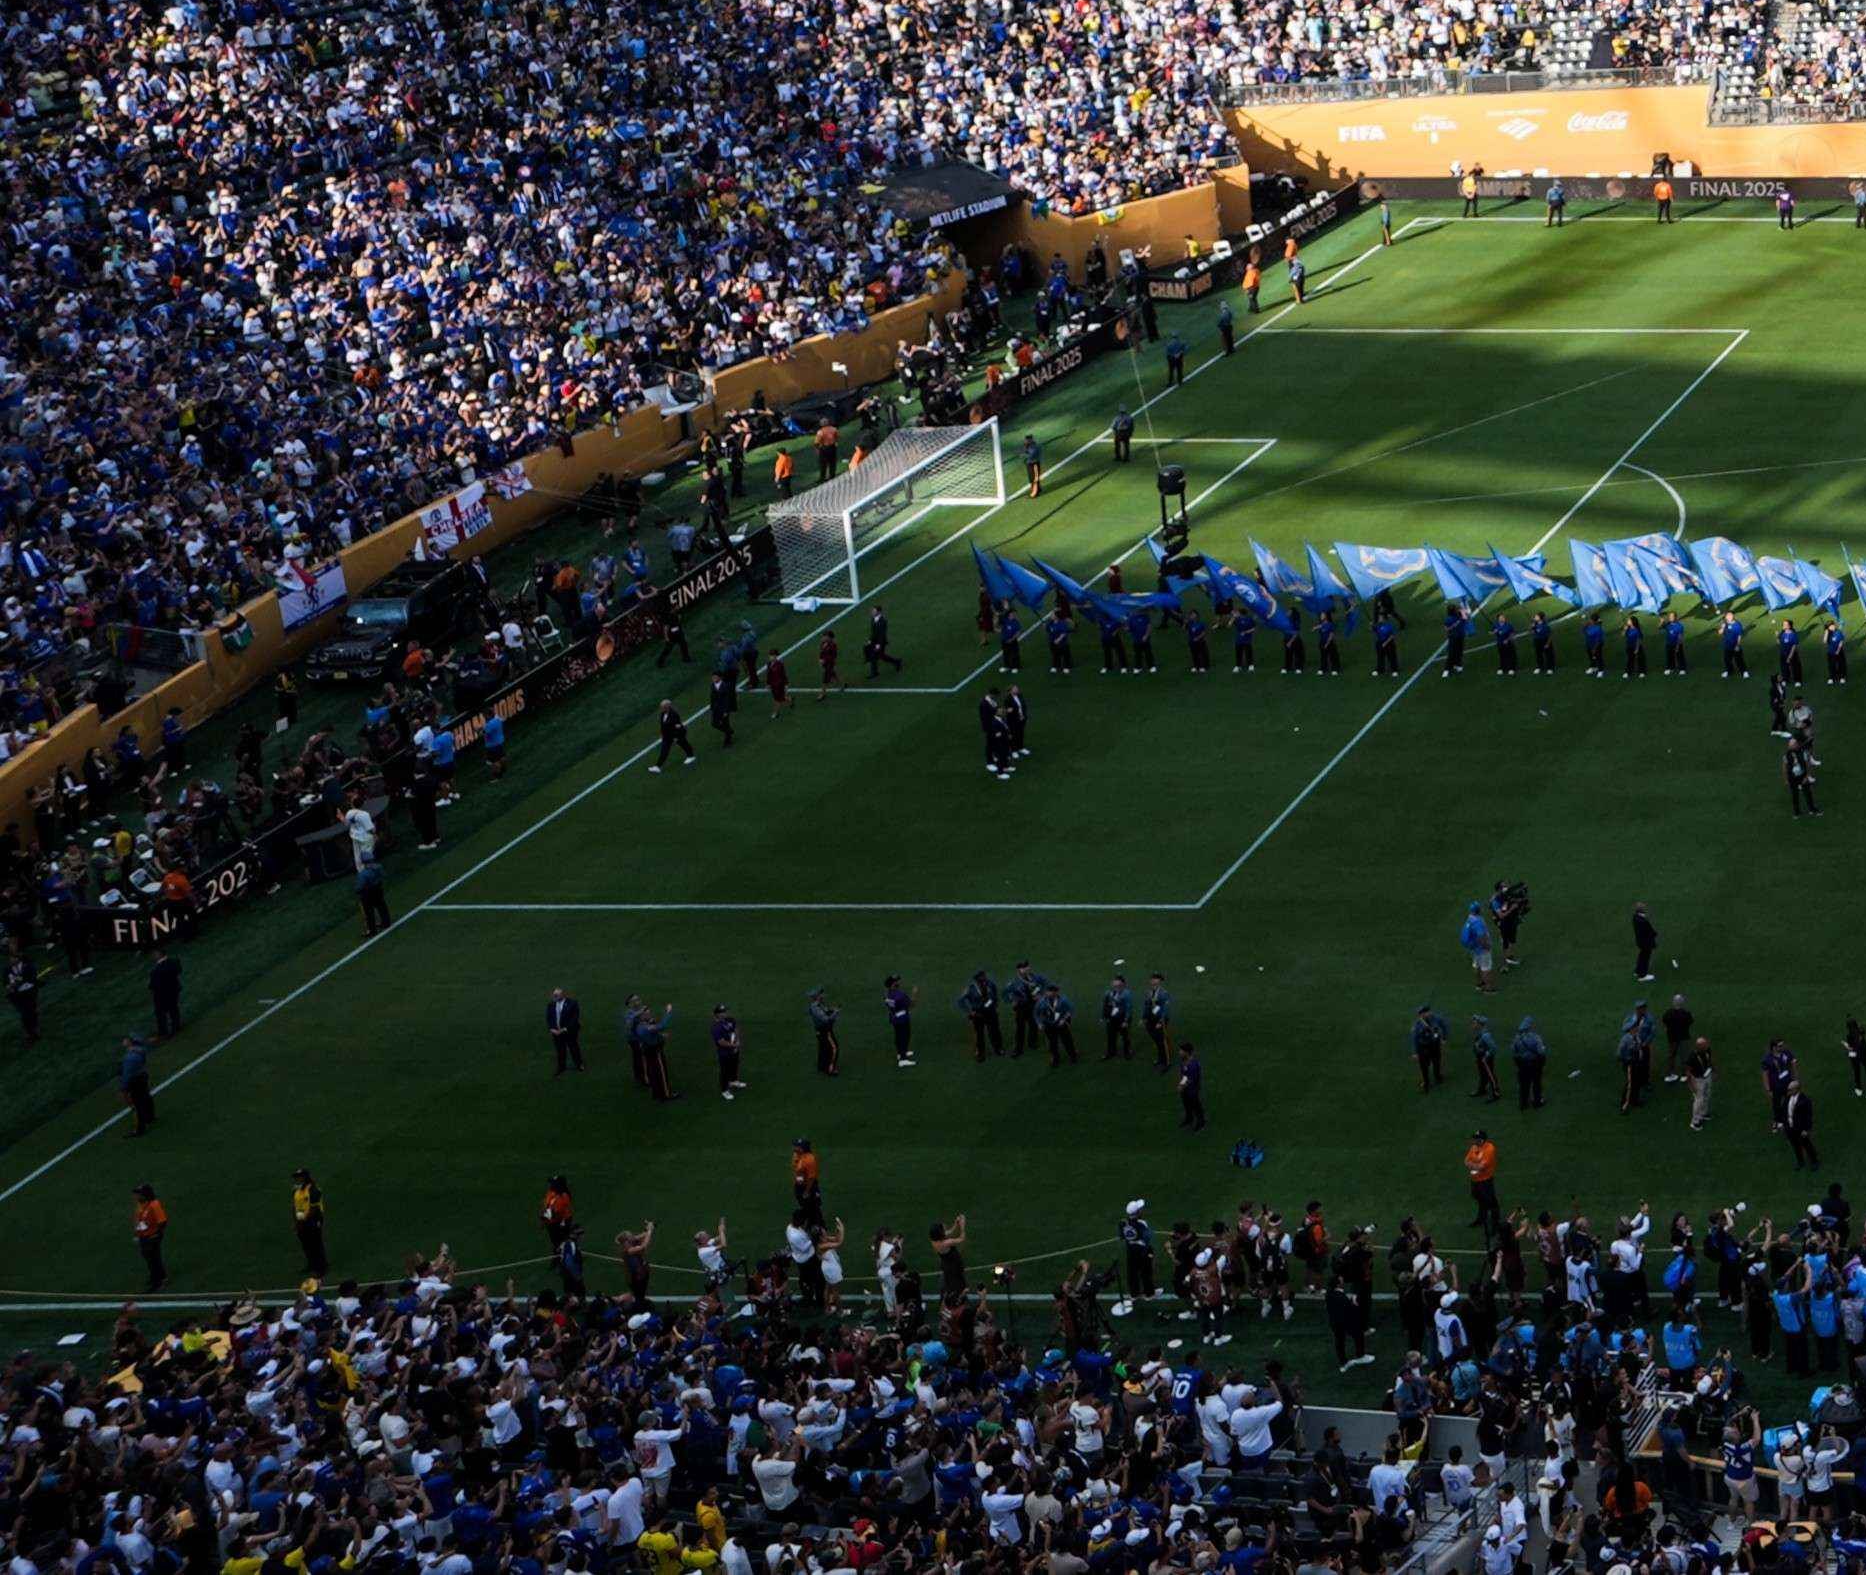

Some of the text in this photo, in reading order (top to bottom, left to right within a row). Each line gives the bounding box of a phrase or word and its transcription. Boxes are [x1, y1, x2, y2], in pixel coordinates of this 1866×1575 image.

[1338, 125, 1386, 142] FIFA
[1690, 181, 1742, 197] FINAL
[1020, 346, 1082, 396] FINAL 2025
[716, 544, 752, 583] 205
[205, 861, 248, 907] 202
[1171, 1379, 1191, 1399] 10
